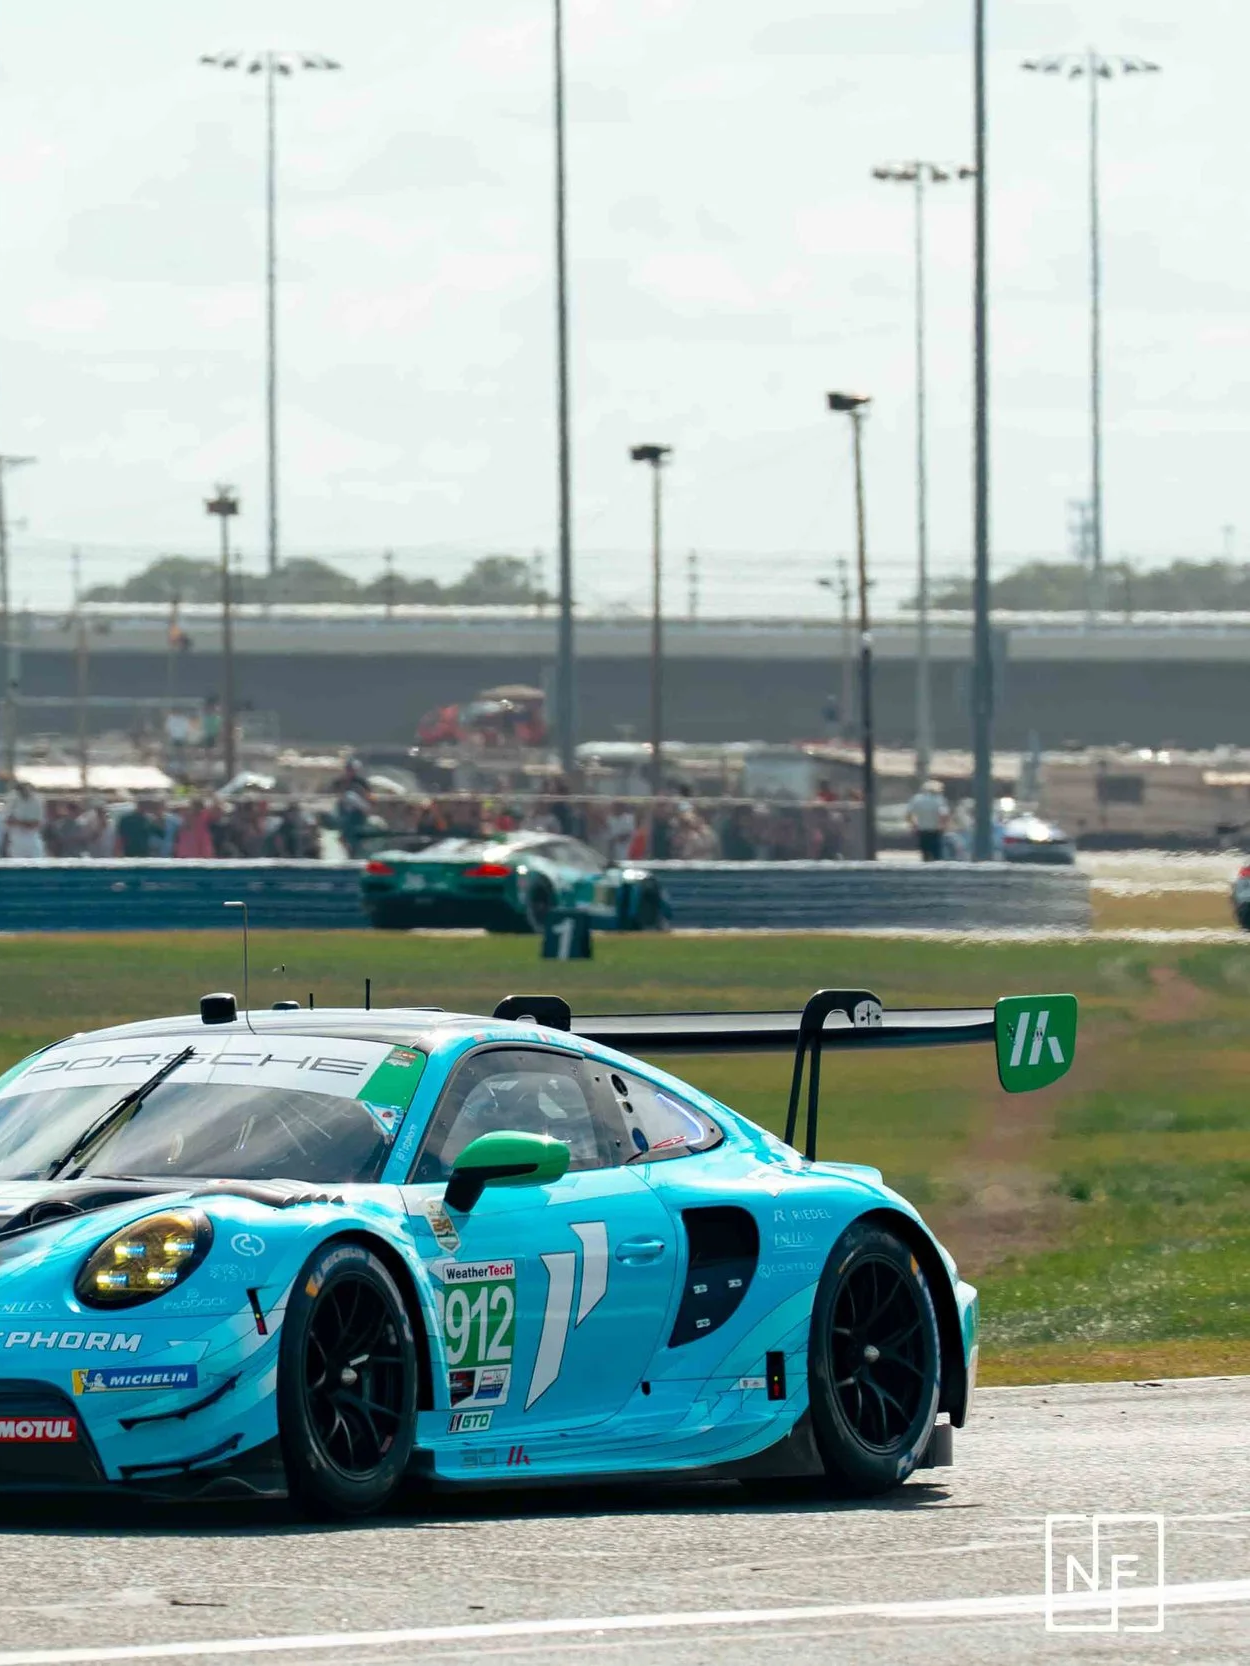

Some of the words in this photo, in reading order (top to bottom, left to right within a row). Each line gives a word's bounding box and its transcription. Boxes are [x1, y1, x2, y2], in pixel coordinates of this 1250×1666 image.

[553, 917, 576, 958] 1
[24, 1052, 368, 1077] PORSCHE
[791, 1208, 833, 1220] RIEDEL
[446, 1263, 513, 1280] WeatherTech
[445, 1285, 515, 1365] 912
[4, 1331, 143, 1353] PHORM
[109, 1372, 188, 1386] MICHELIN
[462, 1413, 490, 1429] GTD
